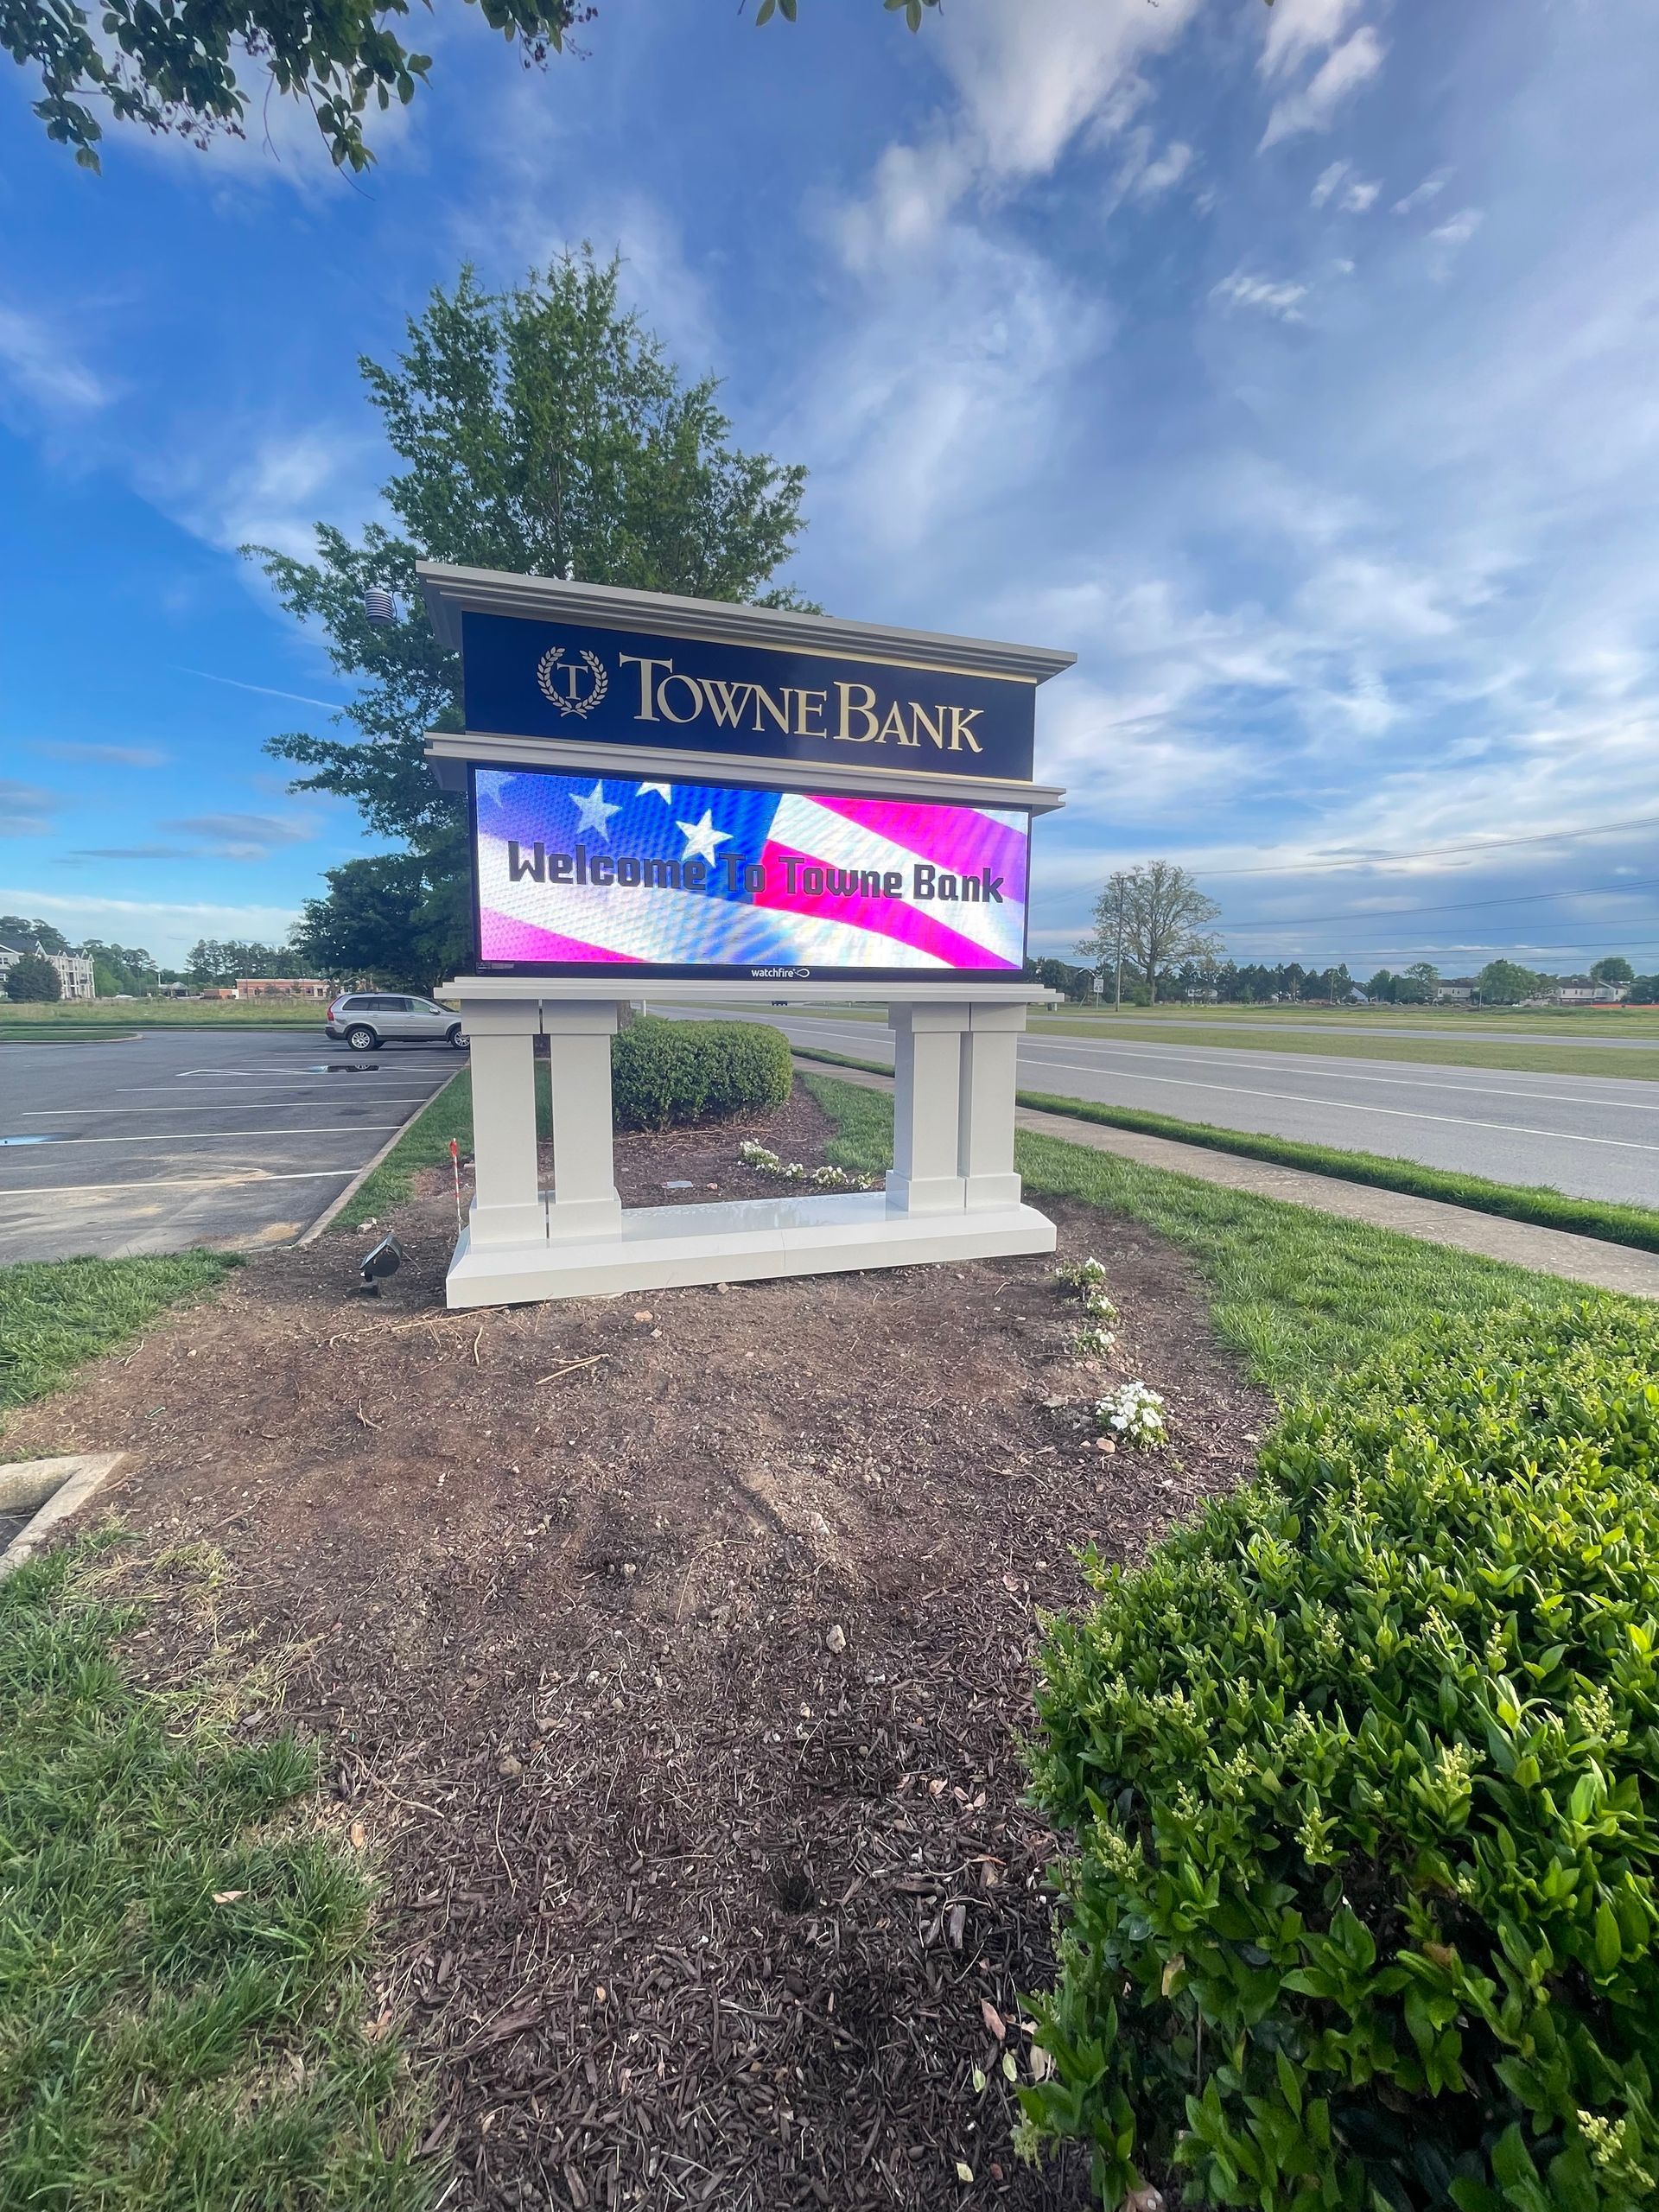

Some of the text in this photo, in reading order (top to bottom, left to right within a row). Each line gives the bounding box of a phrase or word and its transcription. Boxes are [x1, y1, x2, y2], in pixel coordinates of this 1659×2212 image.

[556, 662, 588, 701] T
[508, 840, 1005, 904] Welcome To Towne Bank
[751, 968, 794, 978] watchfire
